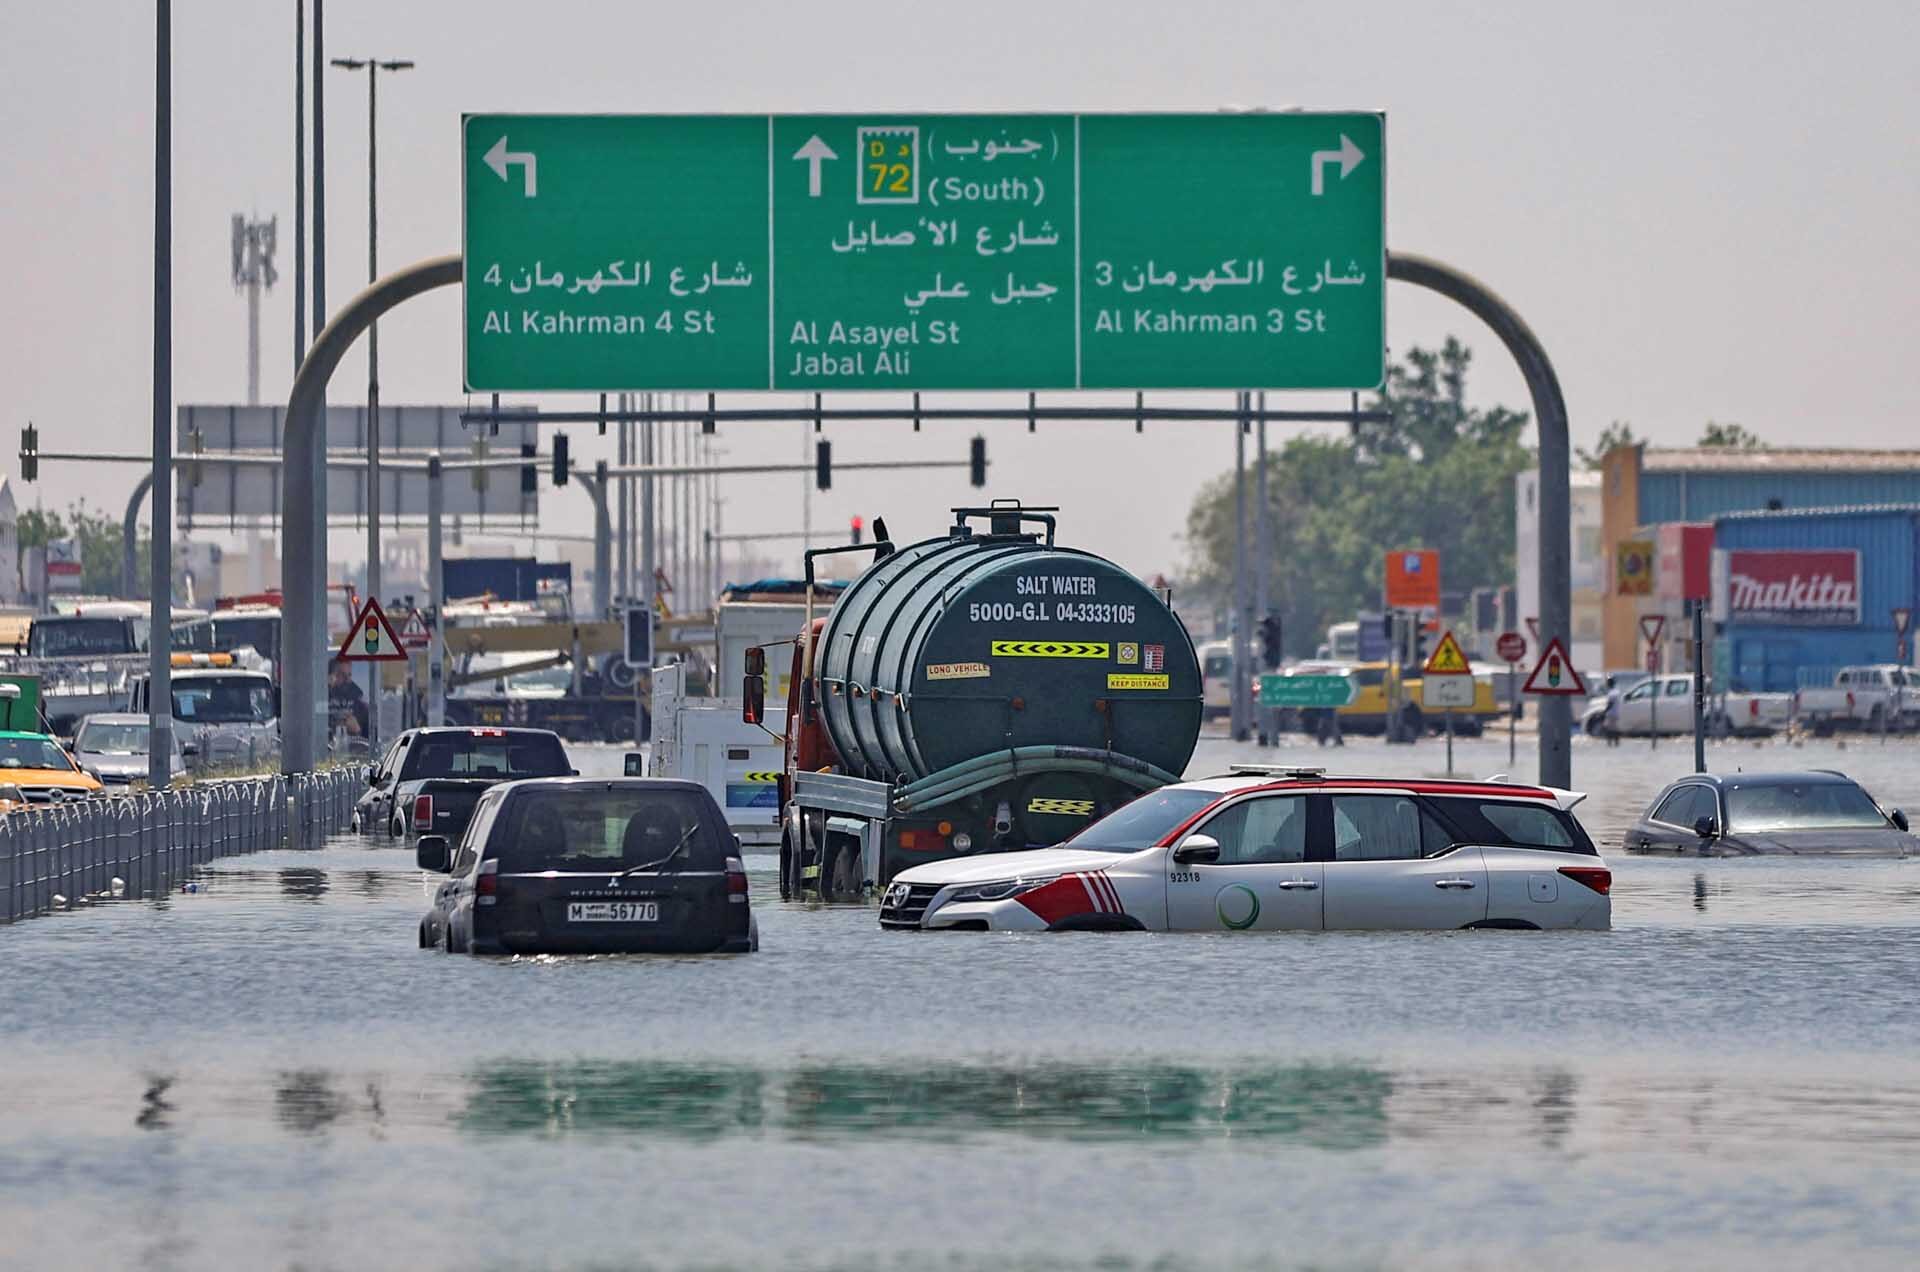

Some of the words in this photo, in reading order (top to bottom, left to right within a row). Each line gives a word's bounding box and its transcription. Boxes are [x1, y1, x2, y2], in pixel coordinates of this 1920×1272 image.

[869, 163, 911, 193] 72
[927, 177, 1045, 206] (South)
[975, 219, 1060, 256] شارع
[482, 262, 502, 287] 4
[509, 259, 651, 295] الكهرمان
[669, 259, 754, 297] شارع
[1094, 261, 1113, 286] 3
[1121, 258, 1264, 293] الكهرمان
[1281, 259, 1366, 296] شارع
[903, 271, 971, 316] علي
[990, 271, 1059, 305] جبل
[482, 310, 512, 334] Al
[522, 310, 646, 334] Kahrman
[654, 310, 674, 333] 4
[683, 309, 716, 334] St
[1094, 309, 1123, 333] Al
[1133, 309, 1257, 333] Kahrman
[1266, 308, 1285, 333] 3
[1294, 308, 1326, 333] St
[789, 320, 818, 345] Al
[828, 319, 919, 349] Asayel
[928, 320, 960, 345] St
[789, 351, 865, 376] Jabal
[873, 350, 910, 375] Ali
[1016, 575, 1049, 595] SALT
[1051, 575, 1096, 596] WATER
[969, 602, 1050, 622] 5000-G.L
[1056, 603, 1136, 624] 04-3333105
[953, 664, 988, 673] VEHICLE
[1110, 680, 1130, 688] KEEP
[1130, 680, 1167, 688] DISTANCE
[1170, 872, 1201, 883] 92318
[571, 904, 583, 919] M
[609, 903, 656, 920] 56770
